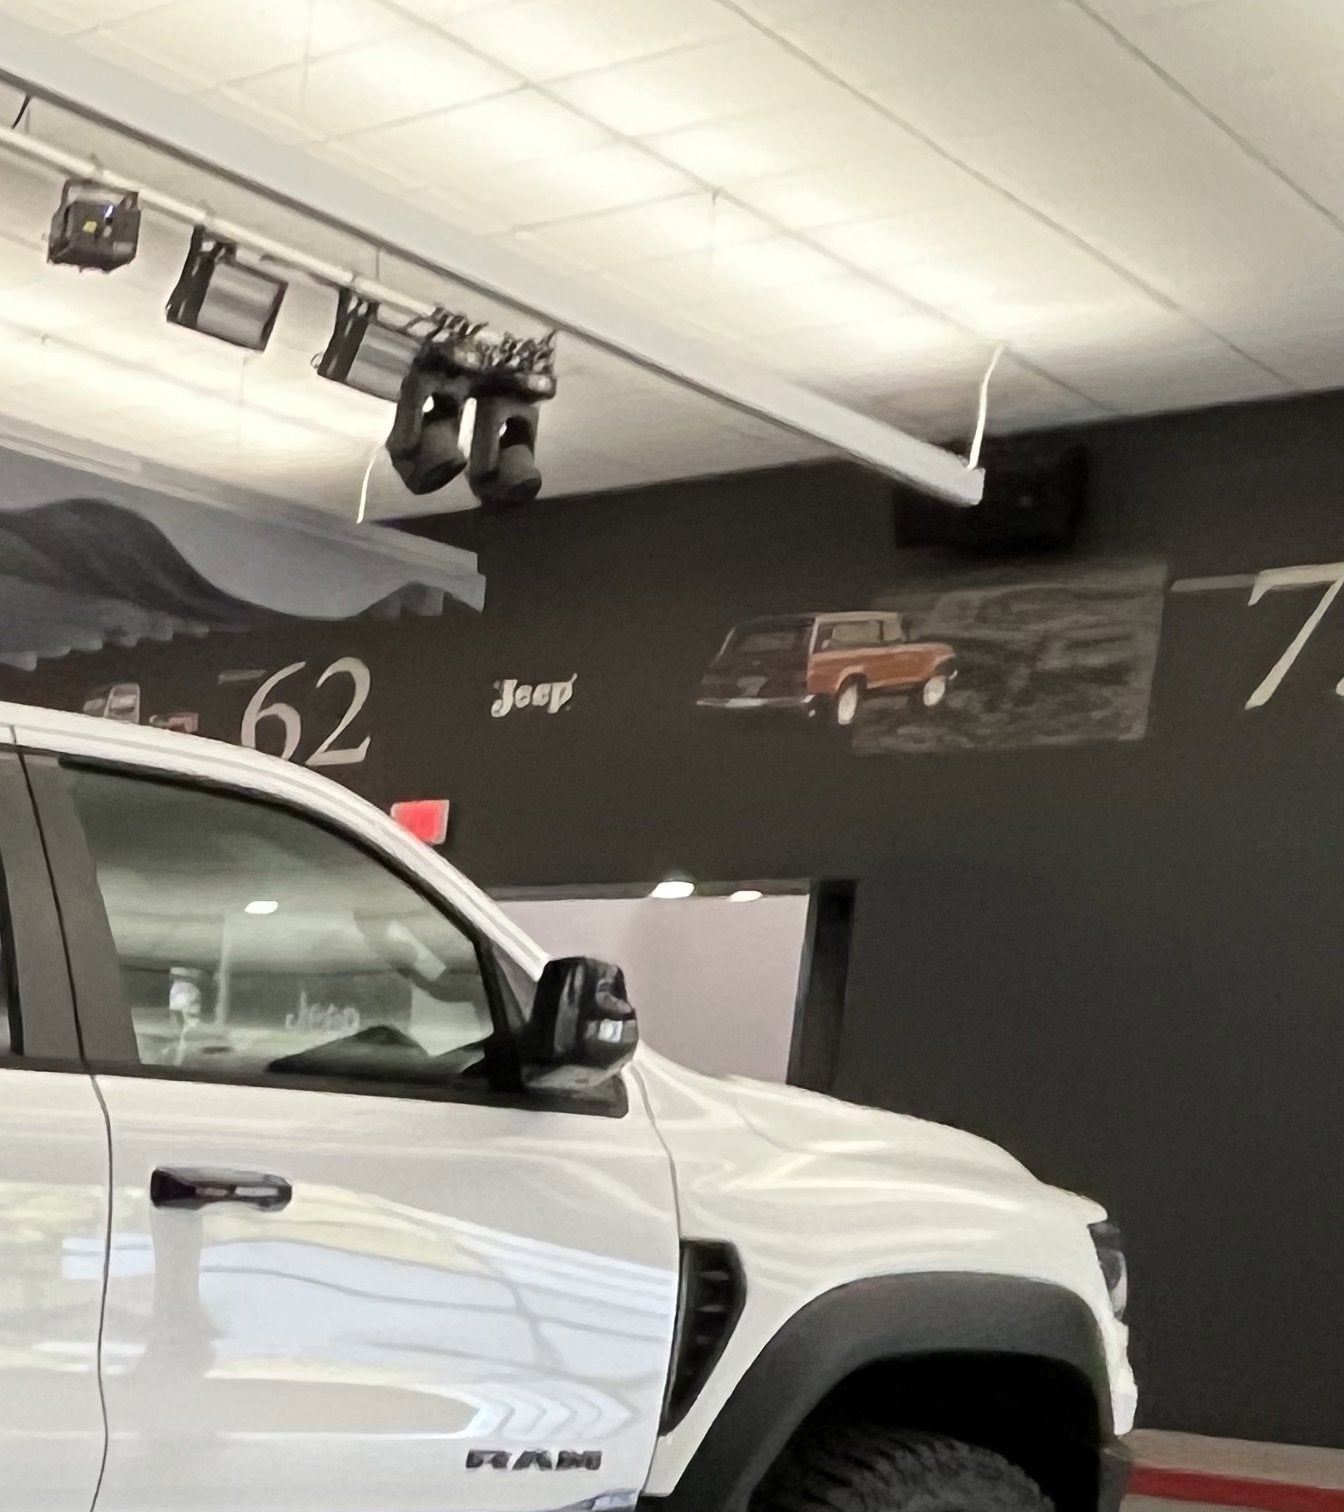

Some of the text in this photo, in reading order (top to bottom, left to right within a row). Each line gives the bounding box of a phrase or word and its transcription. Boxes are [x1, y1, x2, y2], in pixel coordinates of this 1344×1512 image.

[1244, 561, 1344, 710] 7
[240, 656, 372, 766] 62
[490, 672, 577, 718] Jeep
[465, 1449, 603, 1471] RAM
